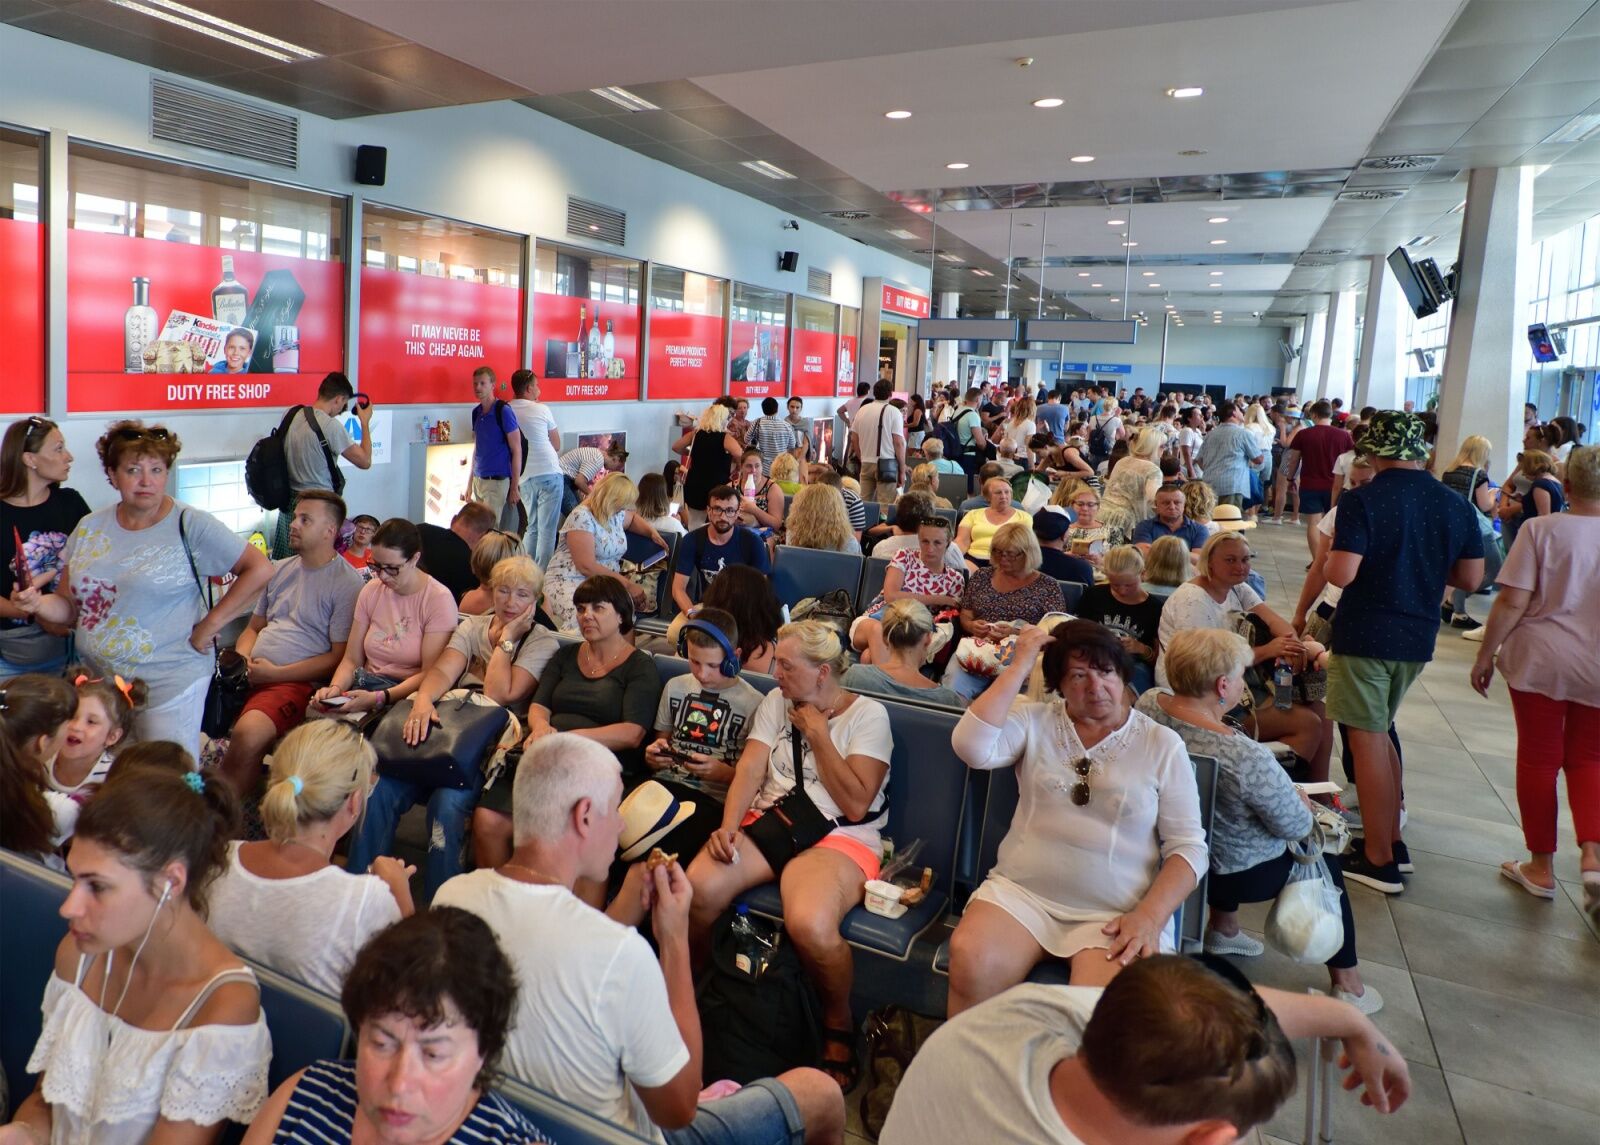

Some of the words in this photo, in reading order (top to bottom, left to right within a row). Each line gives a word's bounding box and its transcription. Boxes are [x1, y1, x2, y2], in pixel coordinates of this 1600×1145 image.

[412, 324, 420, 338] IT
[422, 325, 441, 339] MAY
[442, 326, 468, 341] NEVER
[470, 328, 480, 342] BE
[405, 341, 425, 355] THIS
[429, 342, 456, 356] CHEAP
[458, 344, 484, 358] AGAIN.
[666, 345, 686, 355] PREMIUM
[670, 357, 688, 367] PERFECT
[168, 384, 203, 400] DUTY
[206, 384, 236, 400] FREE
[238, 384, 270, 399] SHOP
[566, 385, 580, 396] DUTY
[582, 385, 594, 395] FREE
[594, 385, 608, 395] SHOP
